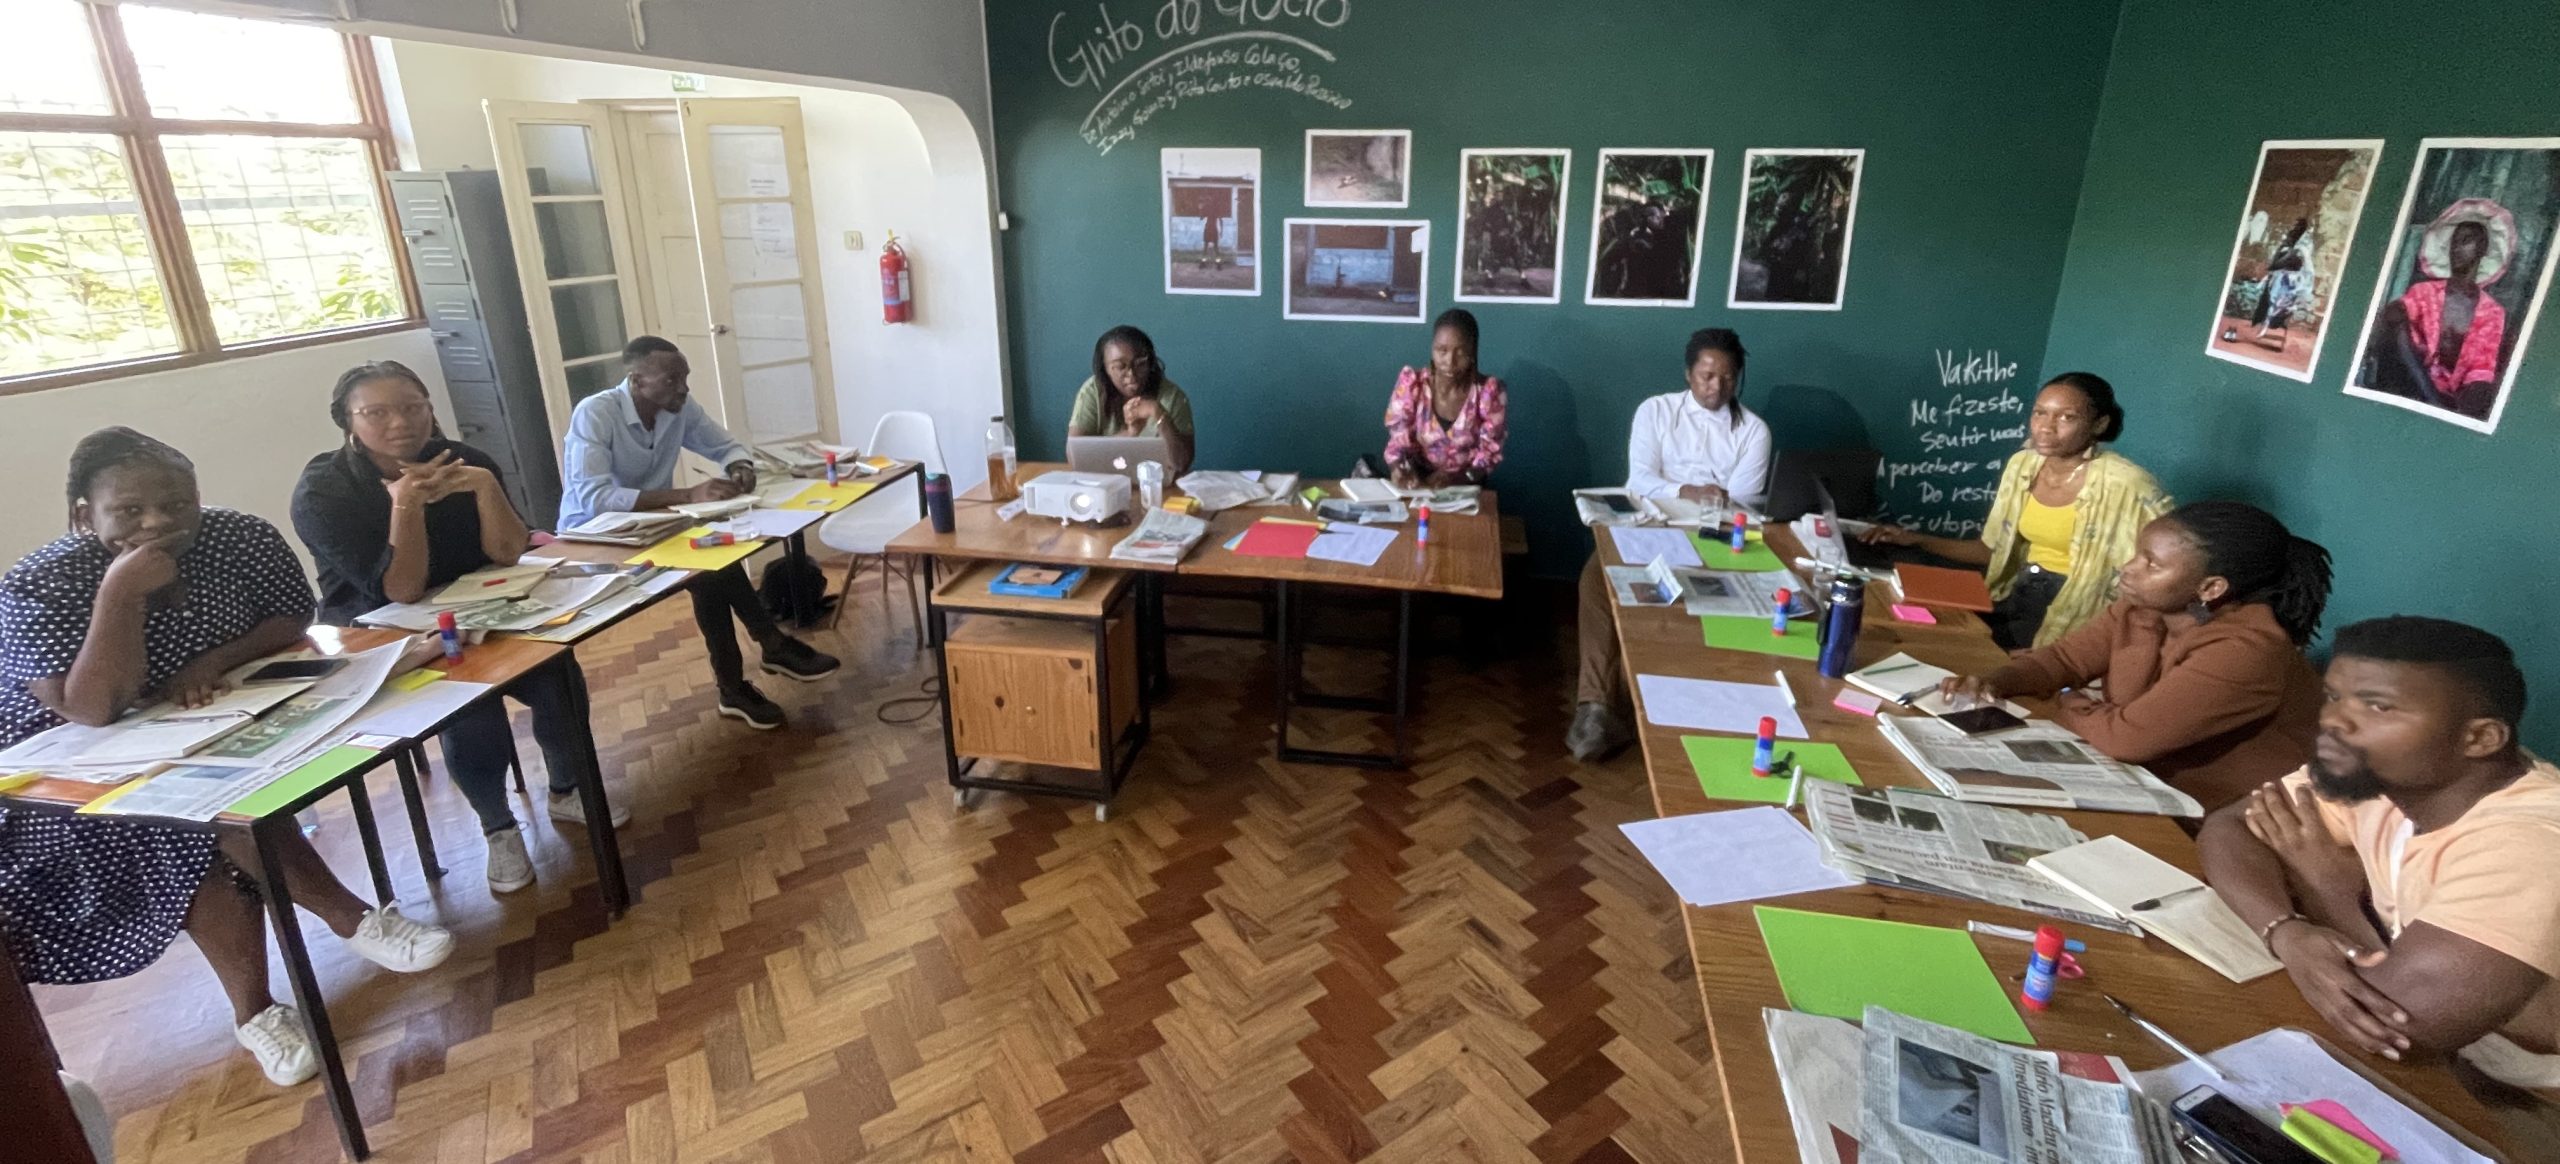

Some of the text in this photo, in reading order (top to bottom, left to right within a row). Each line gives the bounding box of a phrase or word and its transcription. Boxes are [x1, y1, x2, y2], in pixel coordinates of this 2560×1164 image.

[1048, 3, 1143, 92] Grito
[1155, 0, 1200, 39] do
[1911, 398, 1938, 427] Me
[1889, 457, 1978, 490] perceber
[1917, 481, 1943, 503] Do
[1928, 510, 1984, 538] utopi
[2033, 1056, 2053, 1093] Mário
